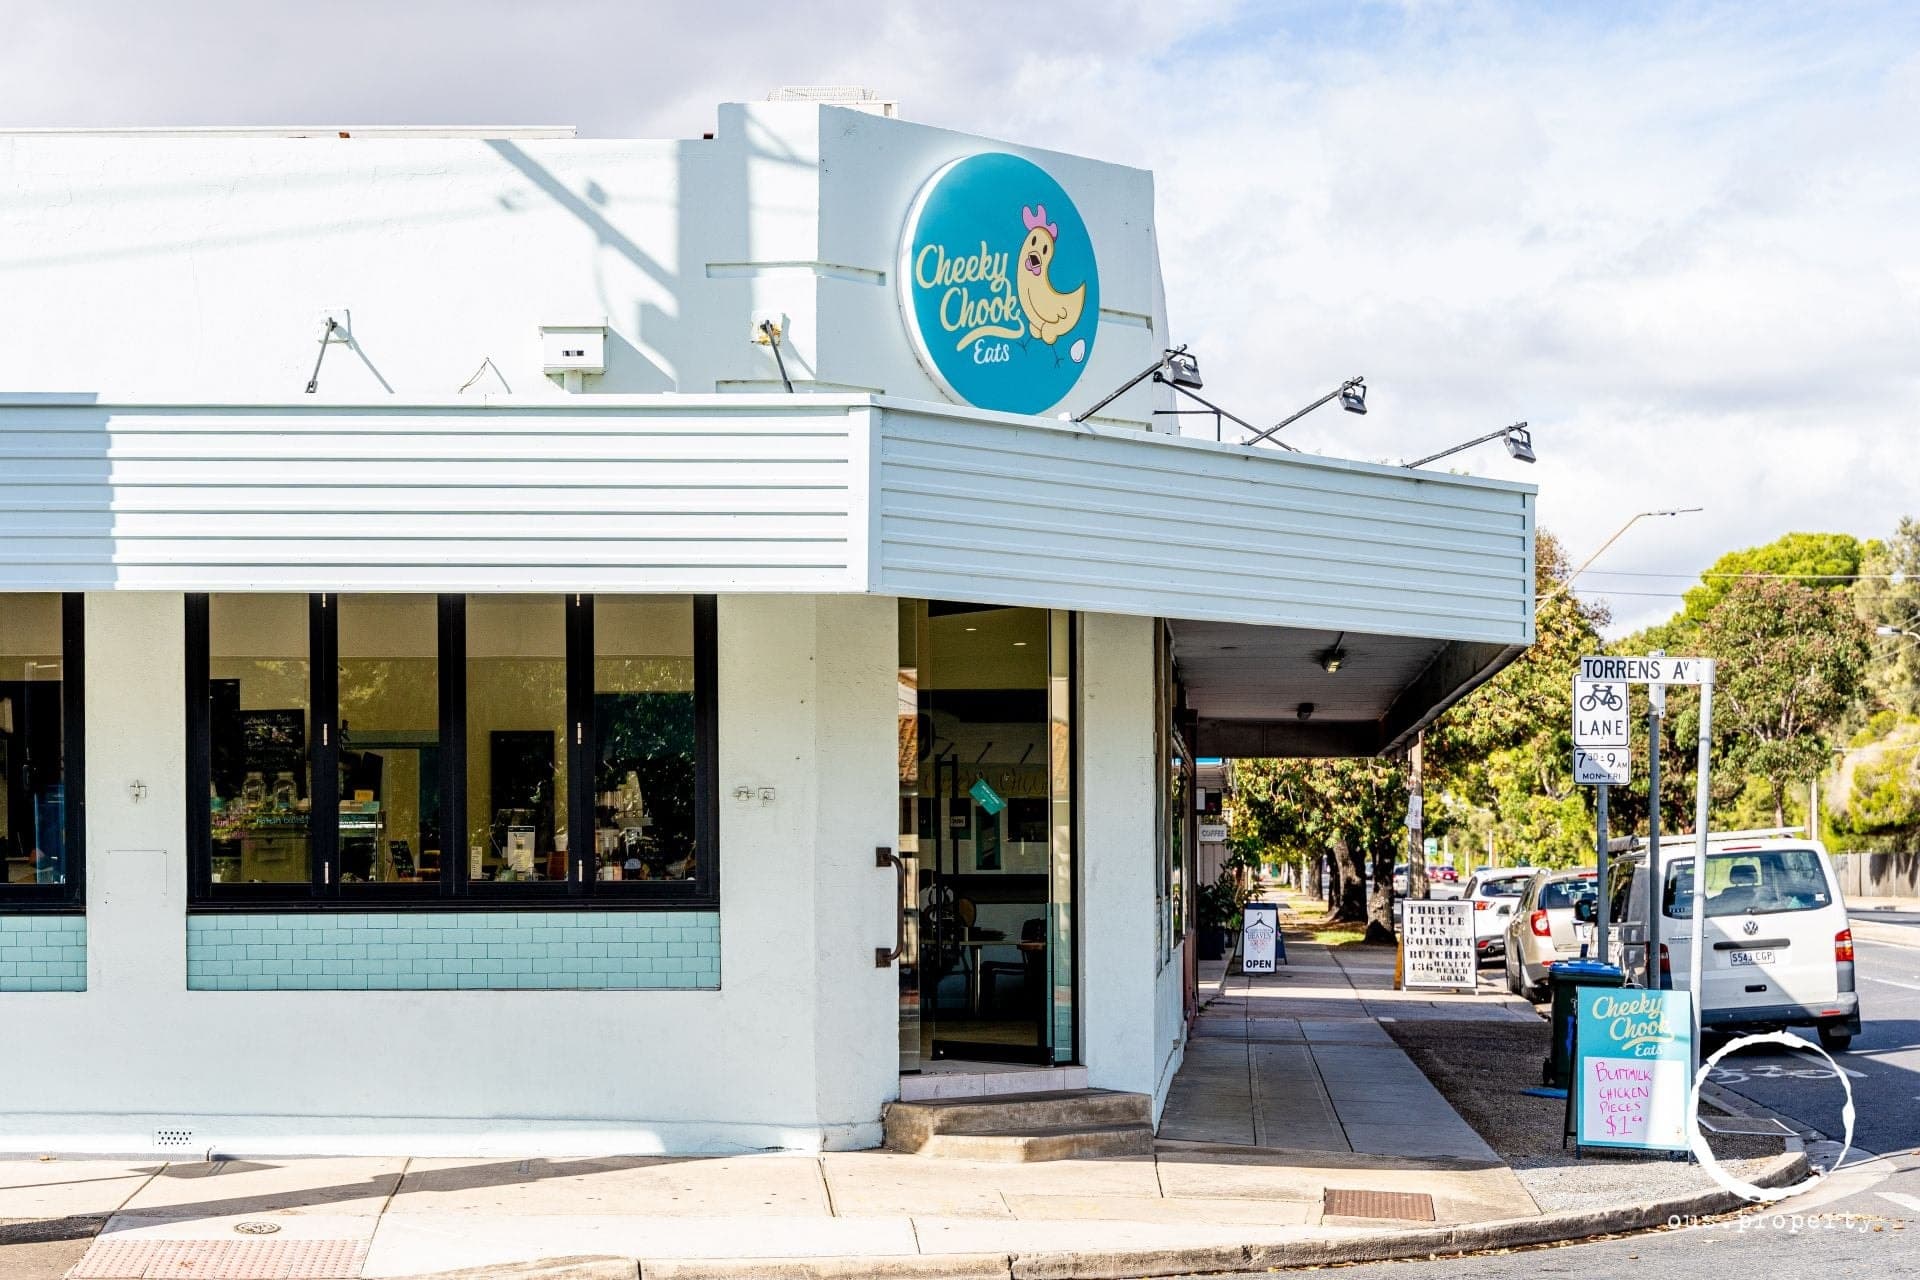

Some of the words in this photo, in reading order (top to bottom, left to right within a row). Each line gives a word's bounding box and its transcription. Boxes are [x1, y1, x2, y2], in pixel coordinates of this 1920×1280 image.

[916, 240, 1010, 292] Cheeky
[940, 282, 1021, 332] Chook
[973, 339, 1010, 364] Eats
[1583, 659, 1660, 679] TORRENS
[1579, 720, 1624, 736] LANE
[1408, 905, 1455, 915] THREE
[1410, 916, 1465, 926] LITTLE
[1410, 926, 1446, 936] PIGS
[1406, 937, 1472, 947] GOURMET
[1409, 950, 1471, 959] BUTCHER
[1246, 960, 1271, 968] OPEN
[1592, 993, 1664, 1019] Cheeky
[1635, 1044, 1664, 1057] Eats
[1599, 1087, 1649, 1100] CHICKEN
[1600, 1101, 1641, 1115] PIECES
